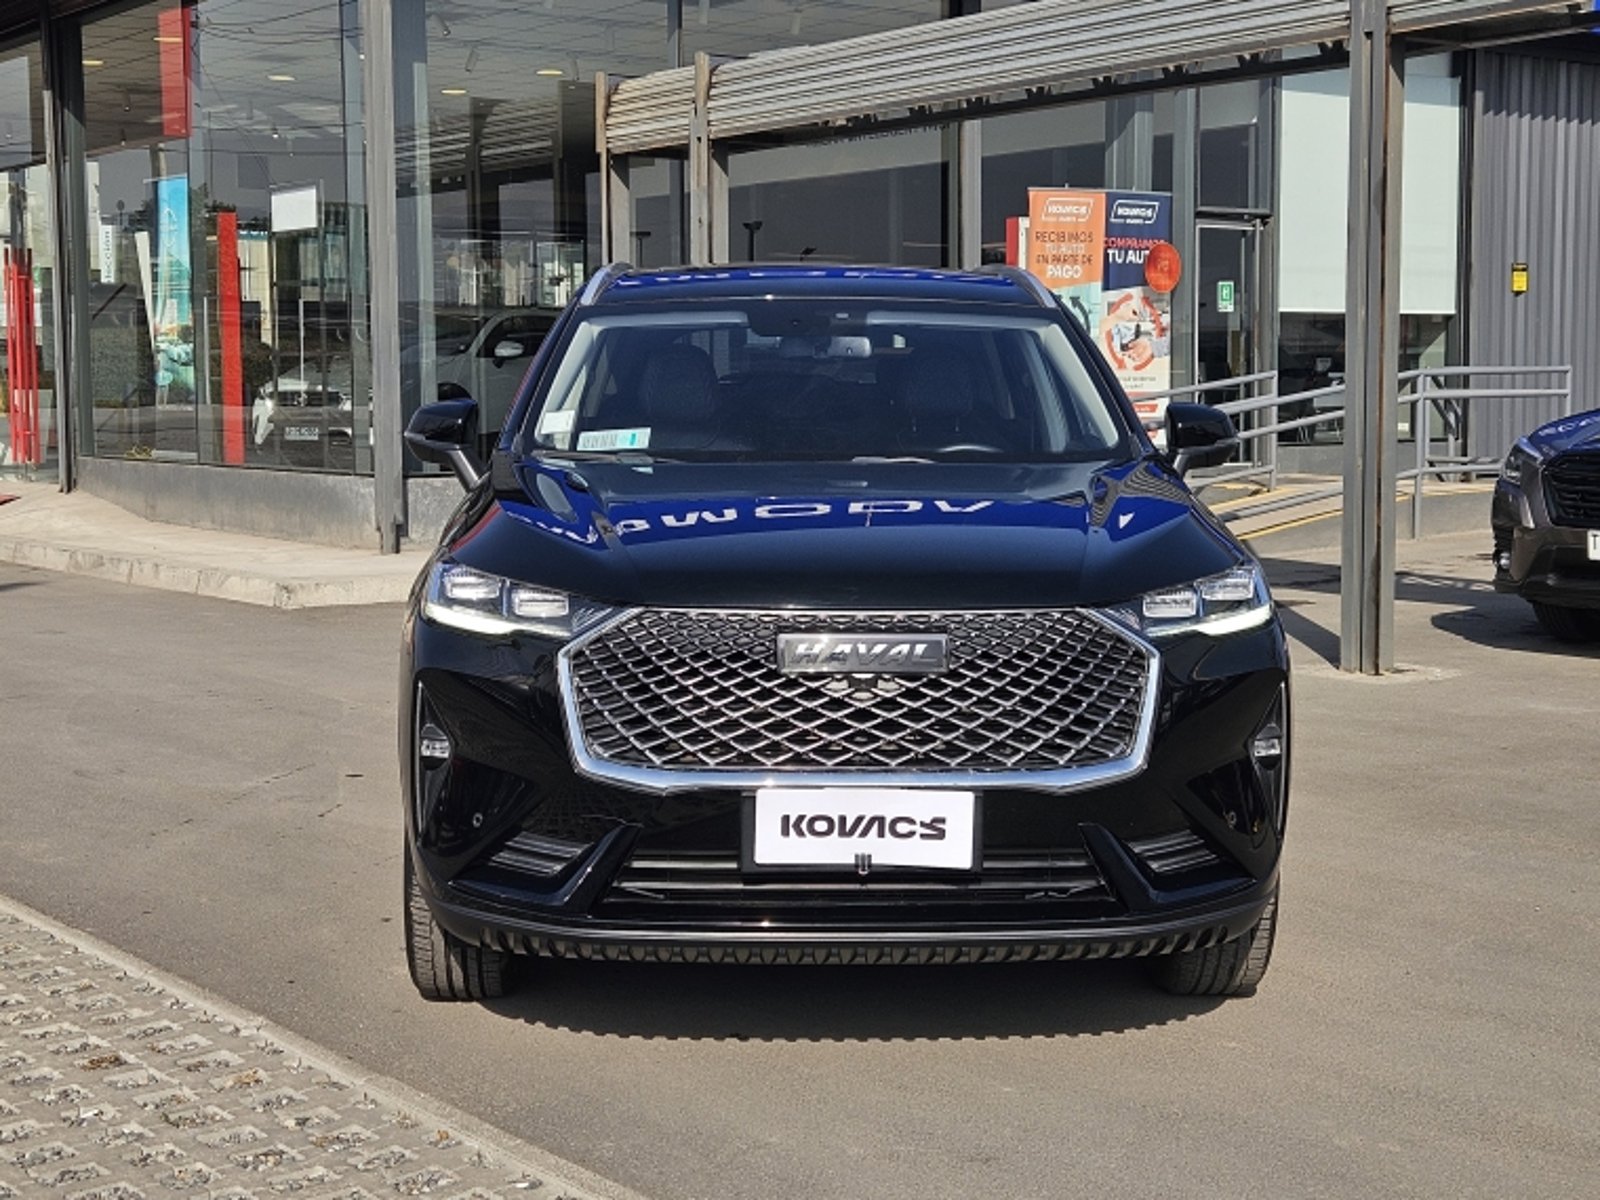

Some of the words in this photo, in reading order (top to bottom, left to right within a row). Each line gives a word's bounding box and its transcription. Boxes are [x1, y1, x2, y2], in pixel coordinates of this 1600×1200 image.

[1035, 231, 1094, 243] RECIBIMOS
[1104, 238, 1166, 249] COMPRAM
[1037, 254, 1048, 264] EN
[1051, 254, 1079, 264] PARTE
[1082, 254, 1093, 264] DE
[1107, 249, 1125, 264] TU
[1126, 250, 1150, 264] AU
[1046, 265, 1082, 278] PAGO
[792, 642, 938, 665] HAVAL
[780, 814, 946, 841] KOVACS
